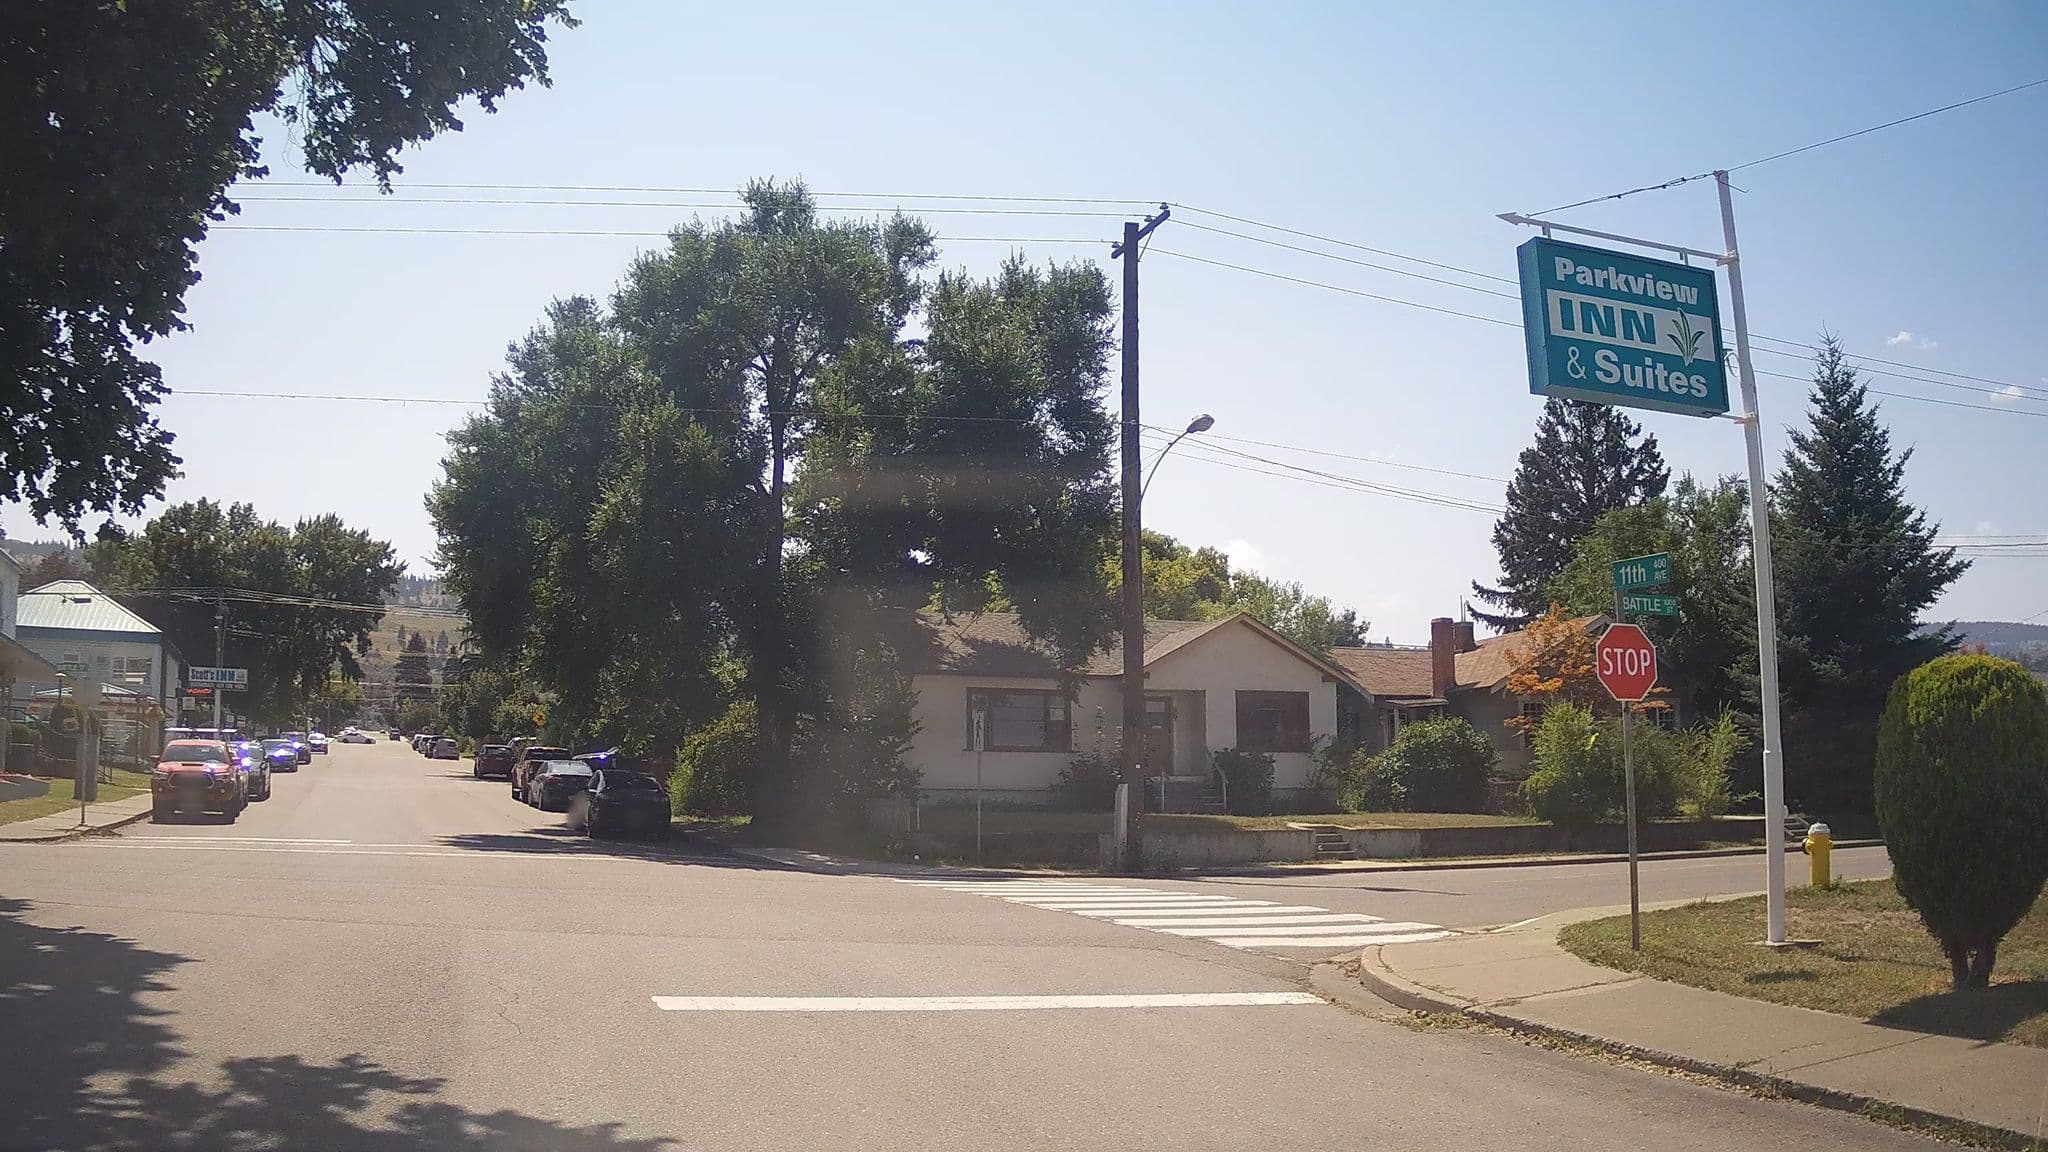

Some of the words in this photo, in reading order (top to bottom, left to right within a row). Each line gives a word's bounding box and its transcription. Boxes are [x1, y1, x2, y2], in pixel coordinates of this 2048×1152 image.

[1555, 256, 1698, 305] Parkview
[1559, 297, 1657, 345] INN
[1566, 346, 1587, 379] &
[1594, 349, 1708, 398] Suites
[1619, 563, 1647, 585] 11th
[1654, 570, 1667, 580] AVE
[1623, 596, 1661, 612] BATTLE
[1602, 647, 1651, 676] STOP
[216, 669, 235, 681] INN
